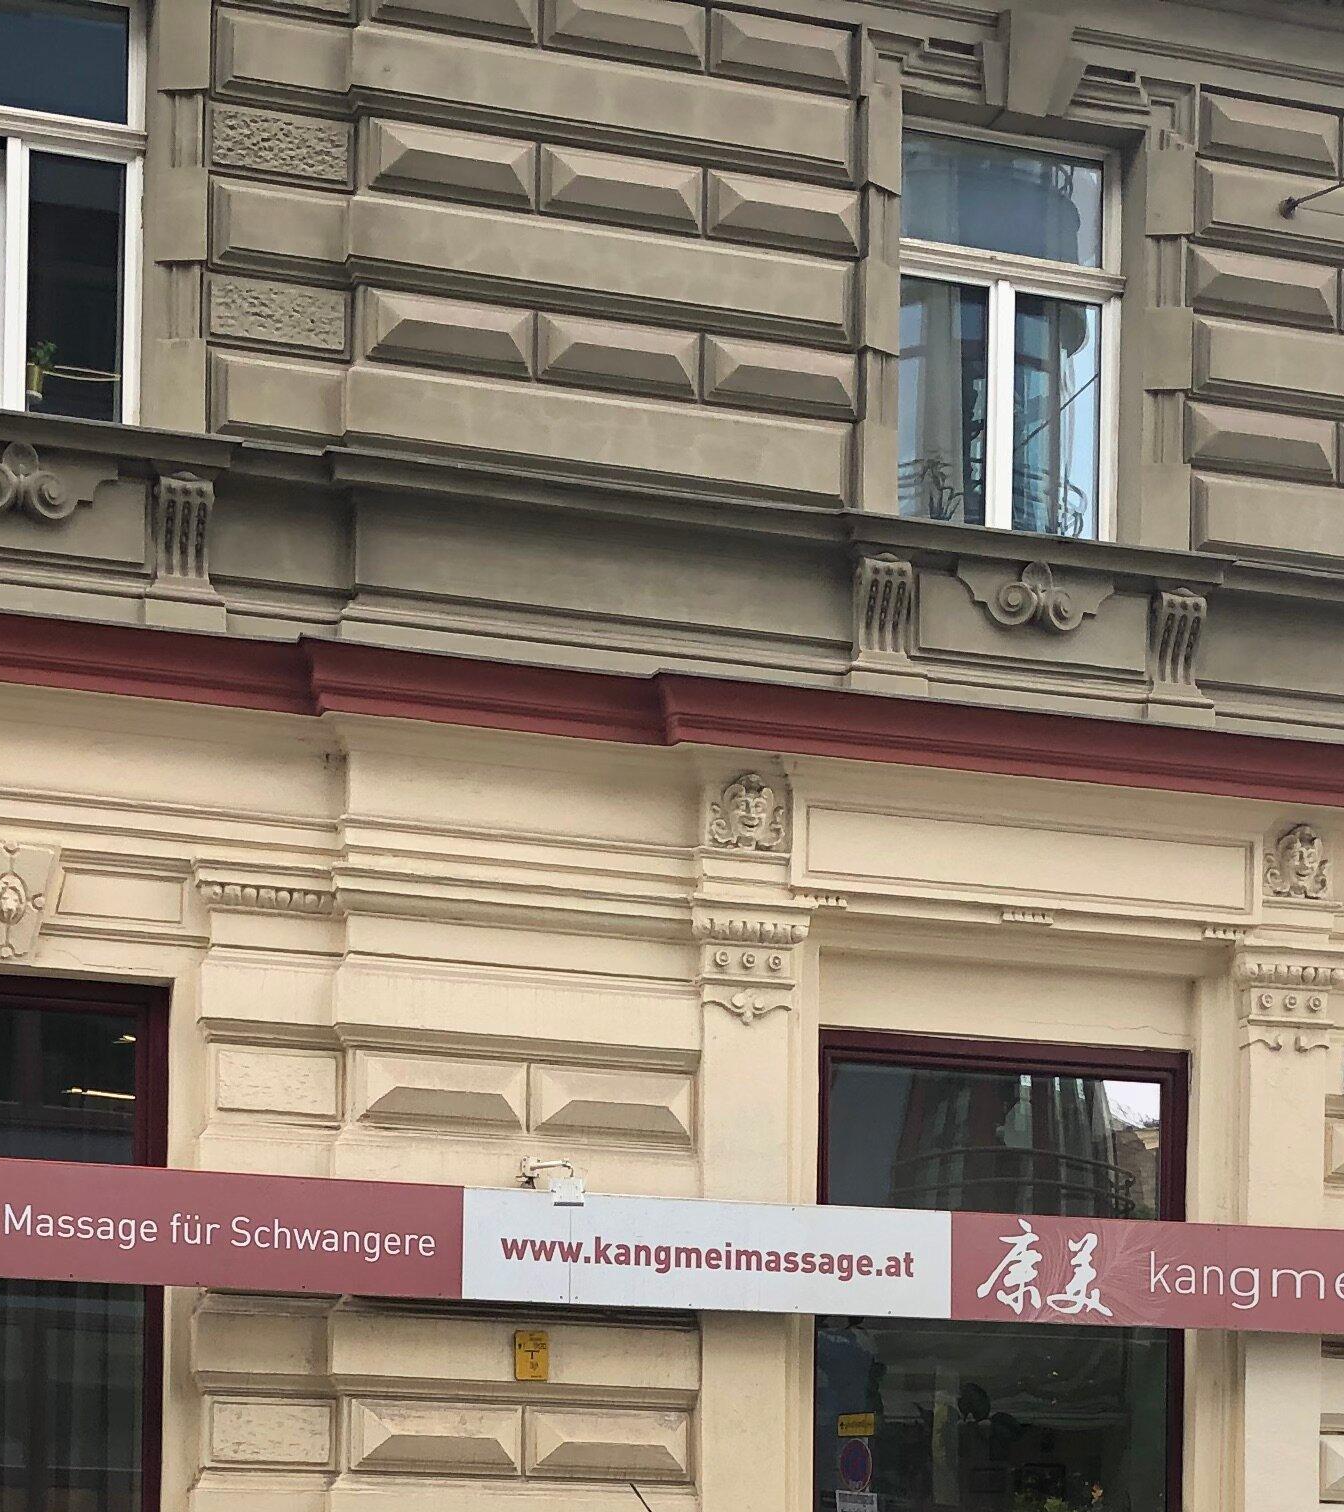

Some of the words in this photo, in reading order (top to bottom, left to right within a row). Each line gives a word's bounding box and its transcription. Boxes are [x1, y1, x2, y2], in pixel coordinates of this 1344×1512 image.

[4, 1203, 158, 1250] Massage
[169, 1212, 221, 1245] für
[230, 1216, 436, 1263] Schwangere
[500, 1235, 914, 1282] www.kangmeimassage.at
